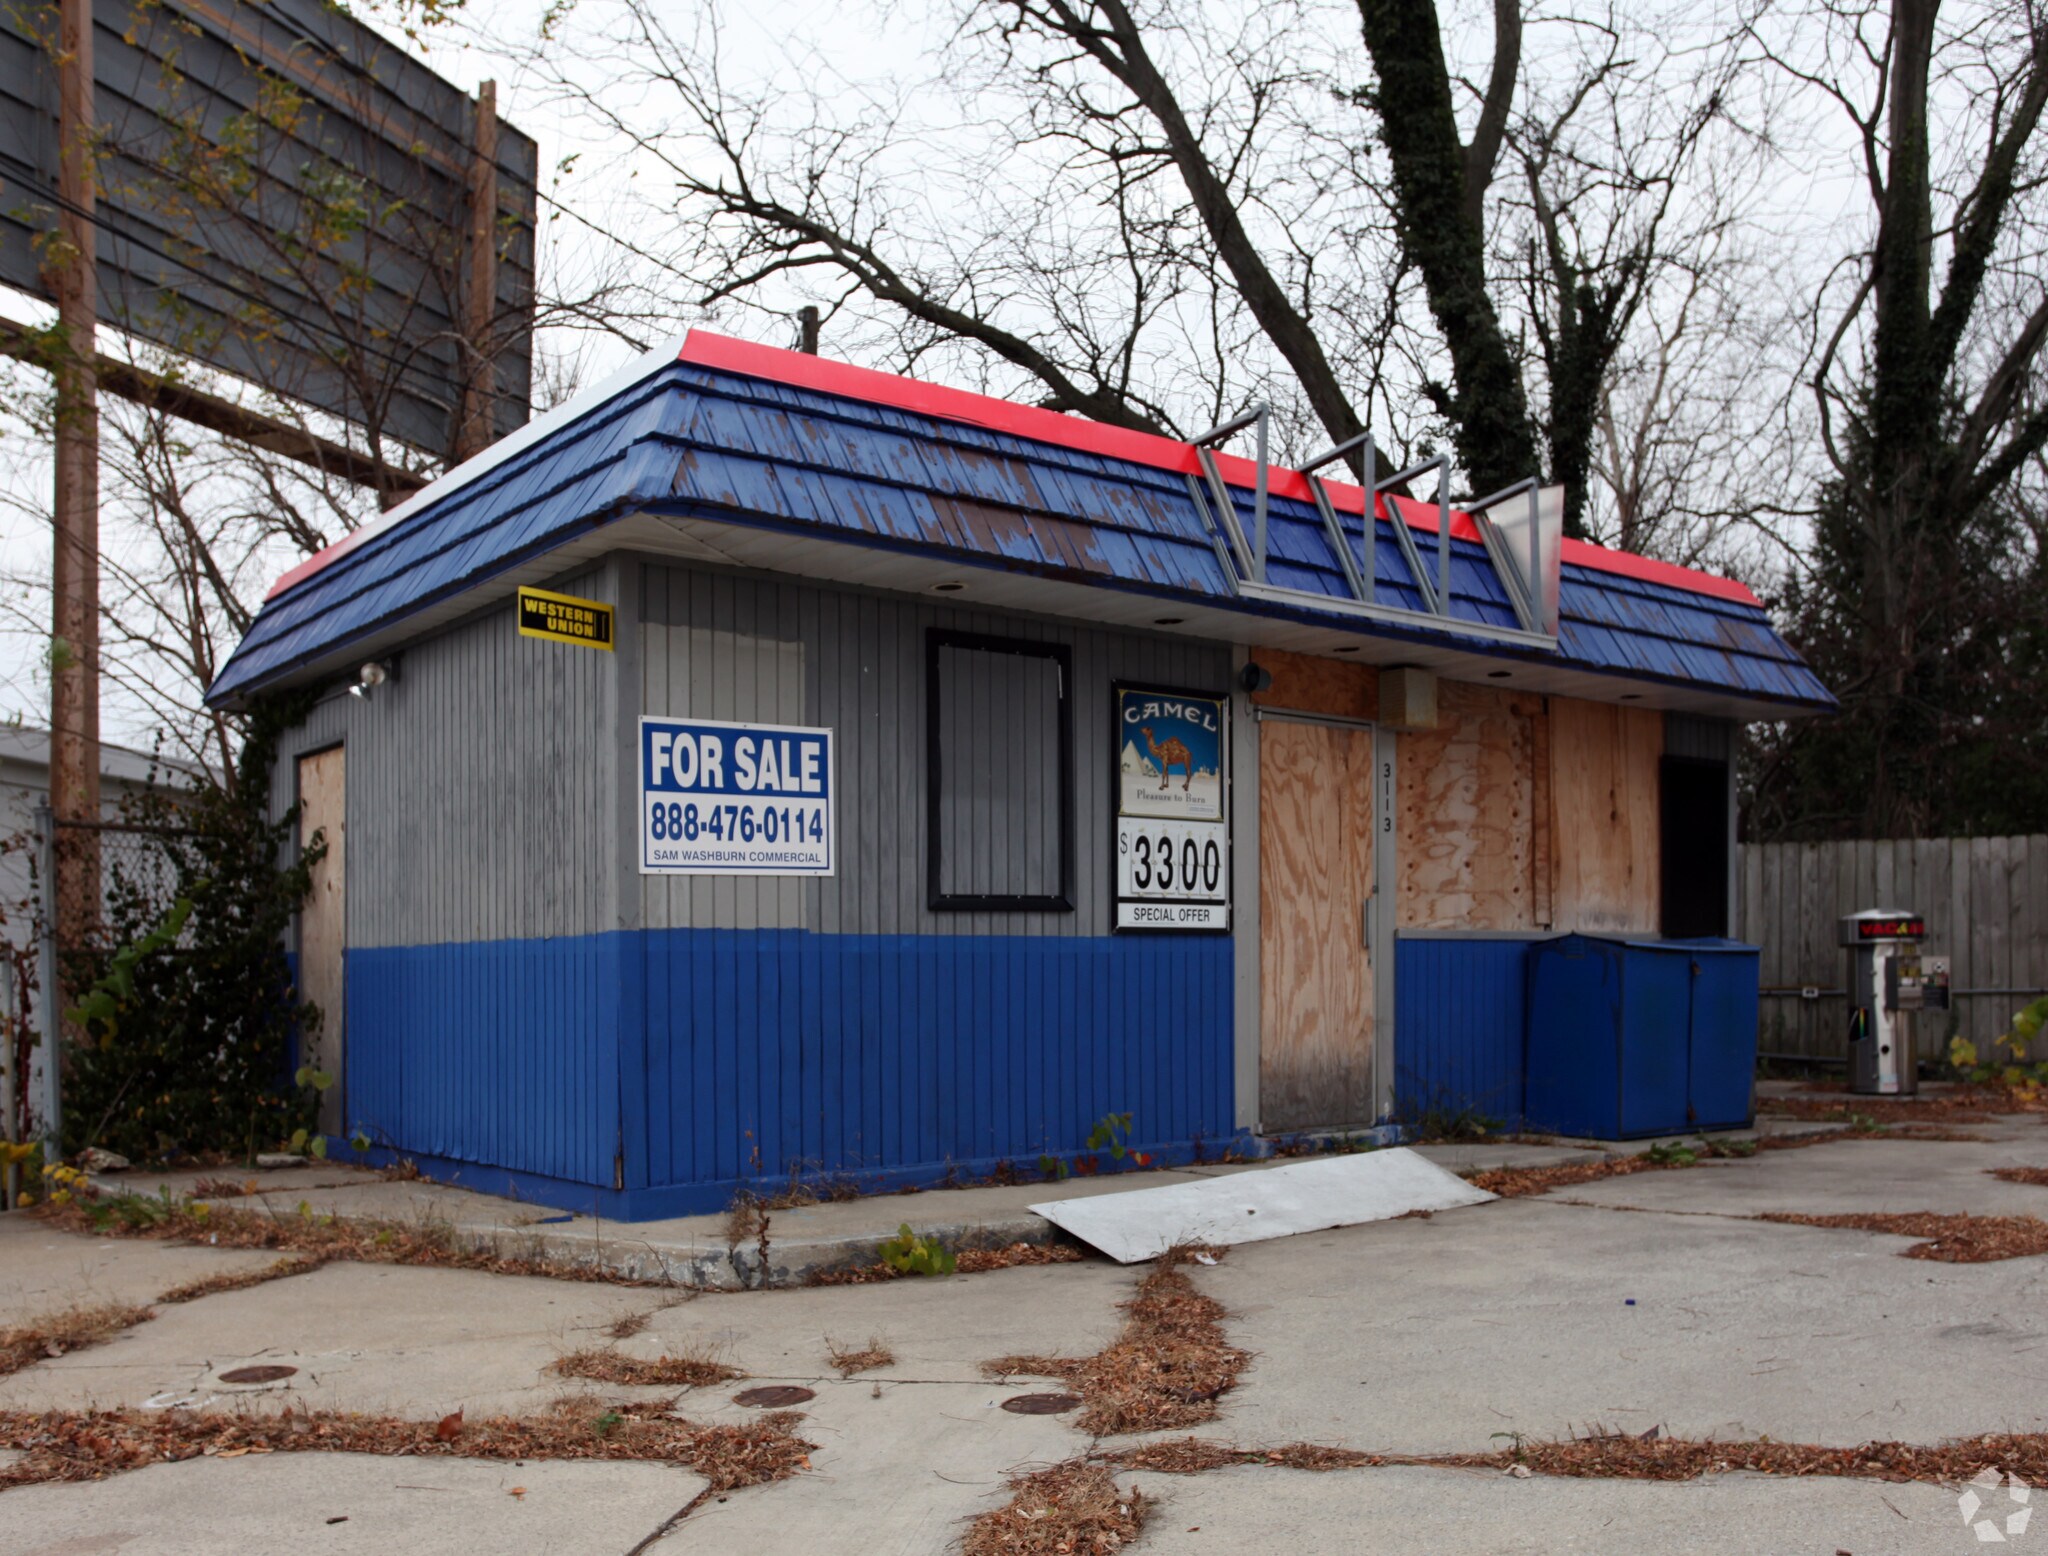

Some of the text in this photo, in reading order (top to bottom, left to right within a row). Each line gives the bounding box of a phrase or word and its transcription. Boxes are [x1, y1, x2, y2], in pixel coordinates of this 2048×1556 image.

[525, 598, 594, 623] WESTERN
[547, 617, 594, 637] UNION
[1124, 702, 1216, 732] CAMEL
[651, 731, 821, 793] FOR SALE
[1137, 788, 1206, 804] Pleasure to Burn
[651, 801, 823, 843] 888-476-0114
[653, 850, 821, 863] SAM WASHBURN COMMERCIAL
[1134, 907, 1210, 922] SPECIAL OFFER
